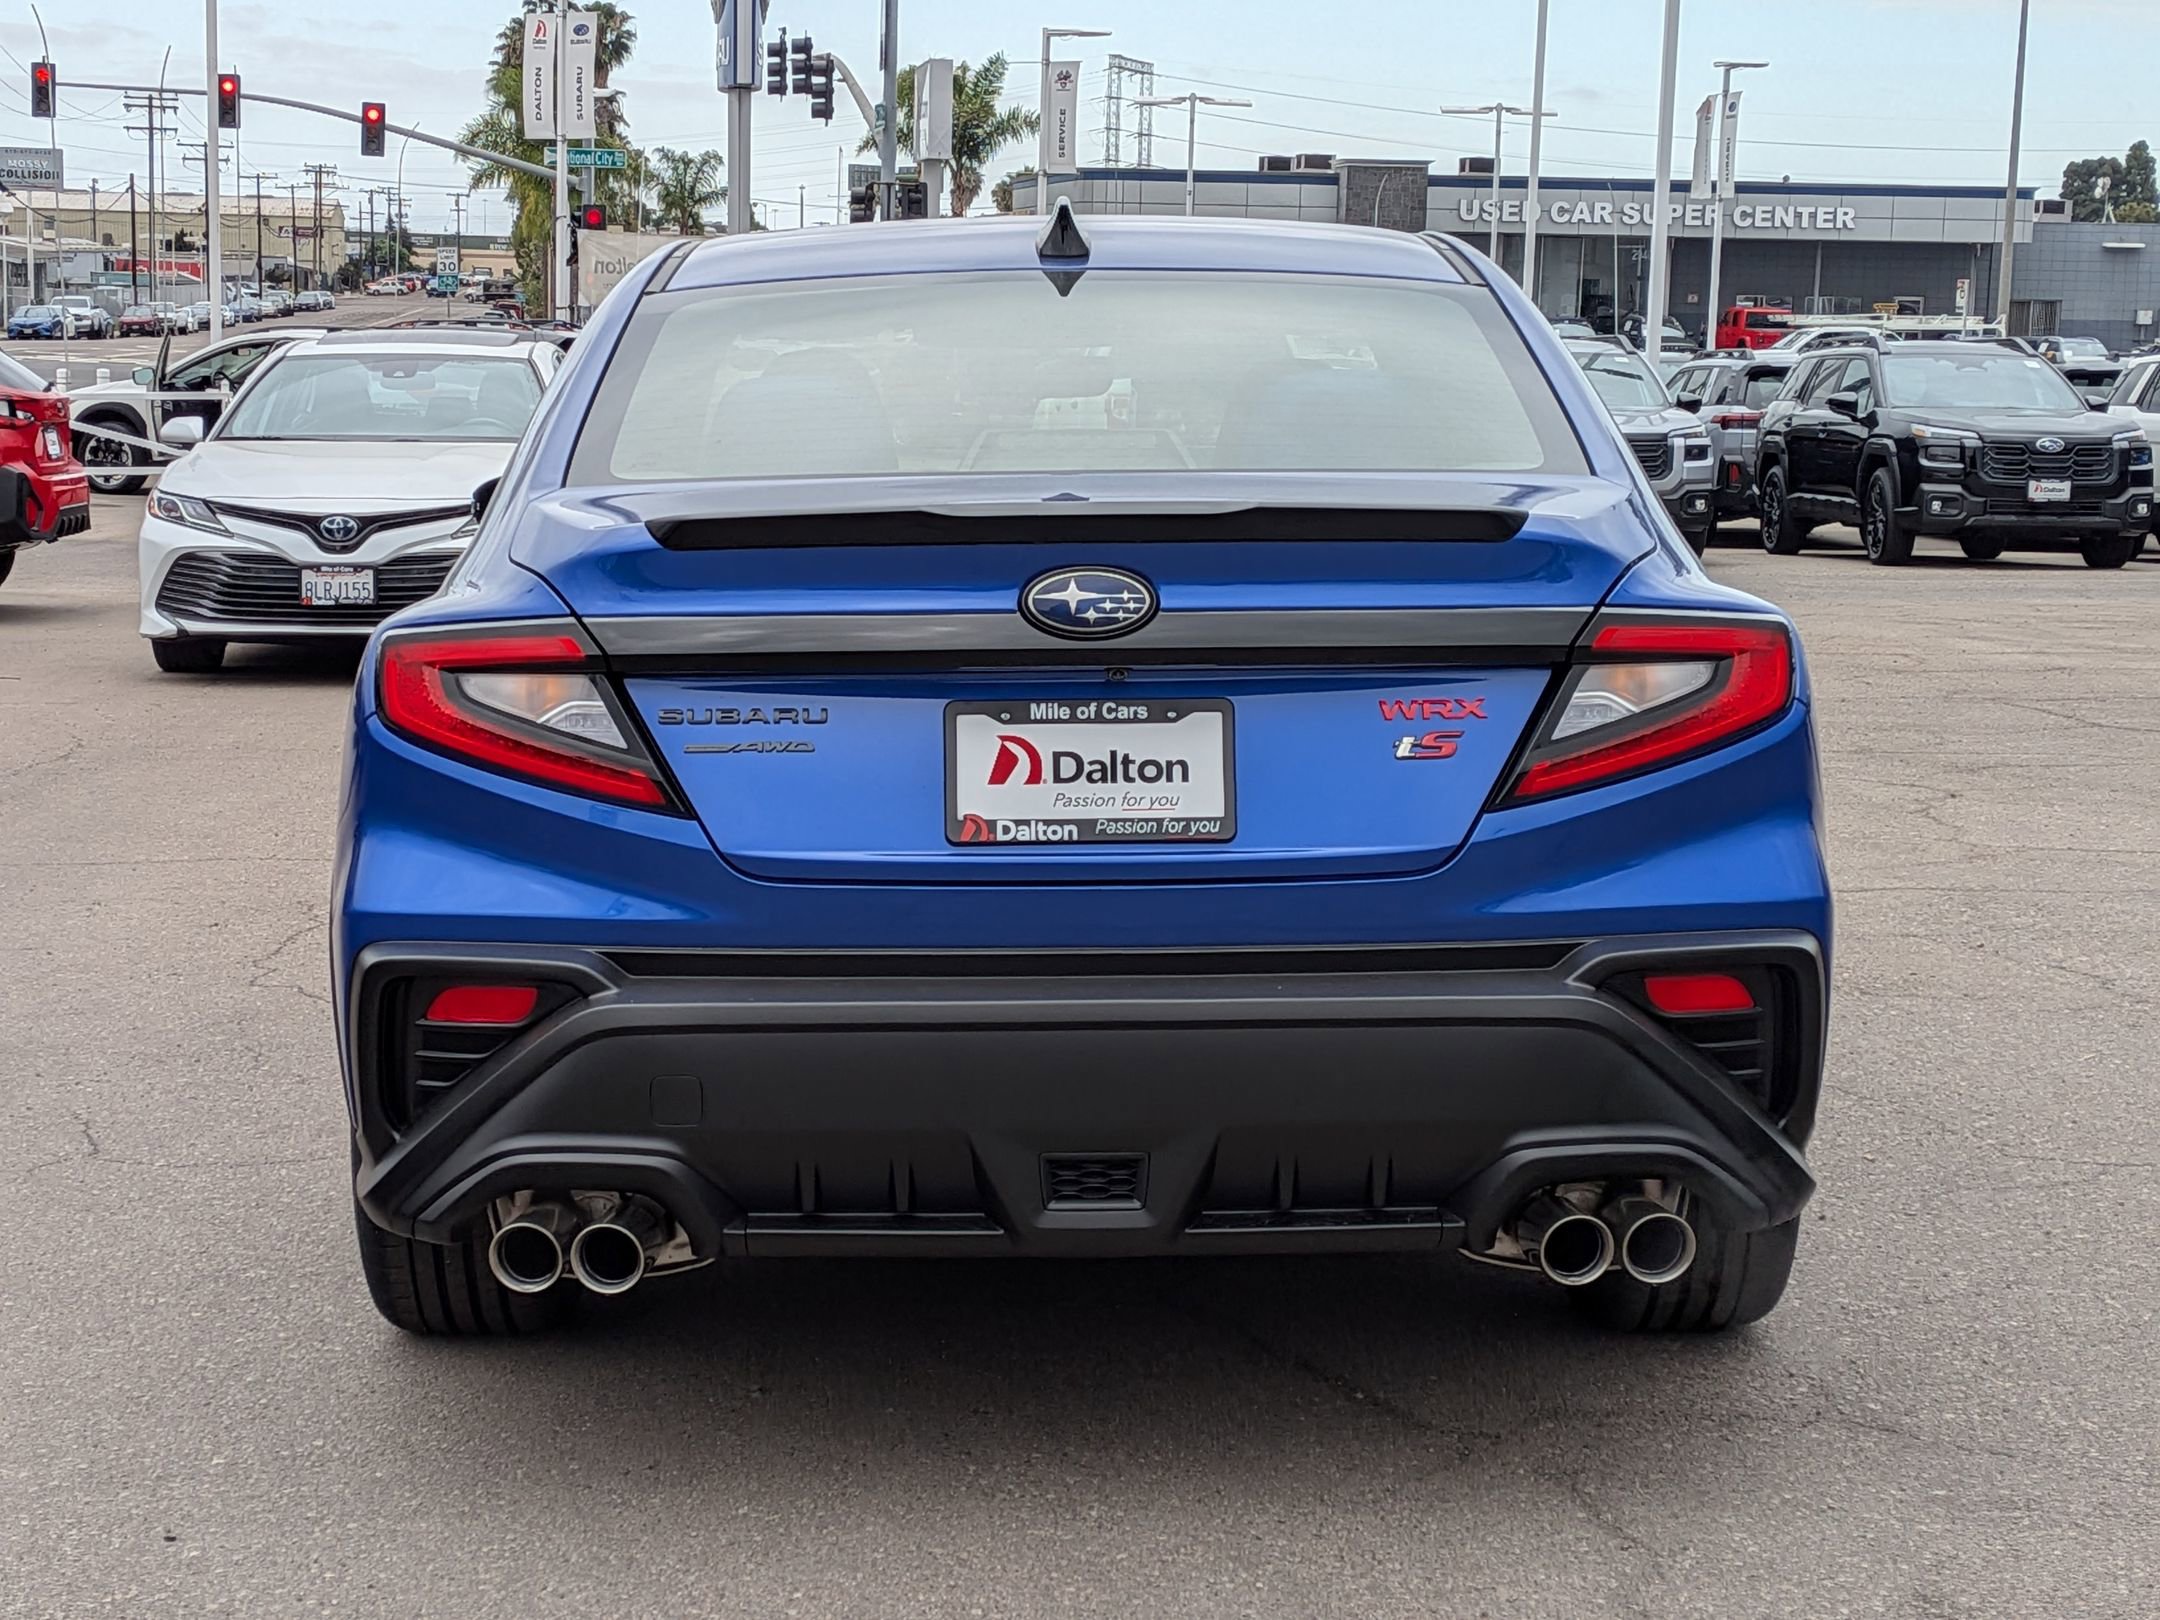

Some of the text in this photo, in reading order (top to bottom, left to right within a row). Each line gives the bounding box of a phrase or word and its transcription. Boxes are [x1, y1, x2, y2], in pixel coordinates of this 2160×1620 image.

[1058, 108, 1066, 158] SERVICE
[7, 159, 49, 169] MOSSY
[595, 151, 614, 167] City
[0, 168, 60, 180] COLLISION
[1550, 201, 1613, 224] CAR
[1733, 205, 1856, 229] CENTER
[439, 261, 456, 272] 30
[304, 580, 371, 602] 8LRJ155
[657, 707, 828, 725] SUBARU
[1030, 702, 1148, 720] Mile of Cars
[1378, 698, 1488, 721] WRX
[732, 740, 816, 753] AWD
[1052, 750, 1190, 785] Dalton
[1053, 791, 1180, 811] Passion for you
[996, 817, 1221, 842] Dalton Passion for you
